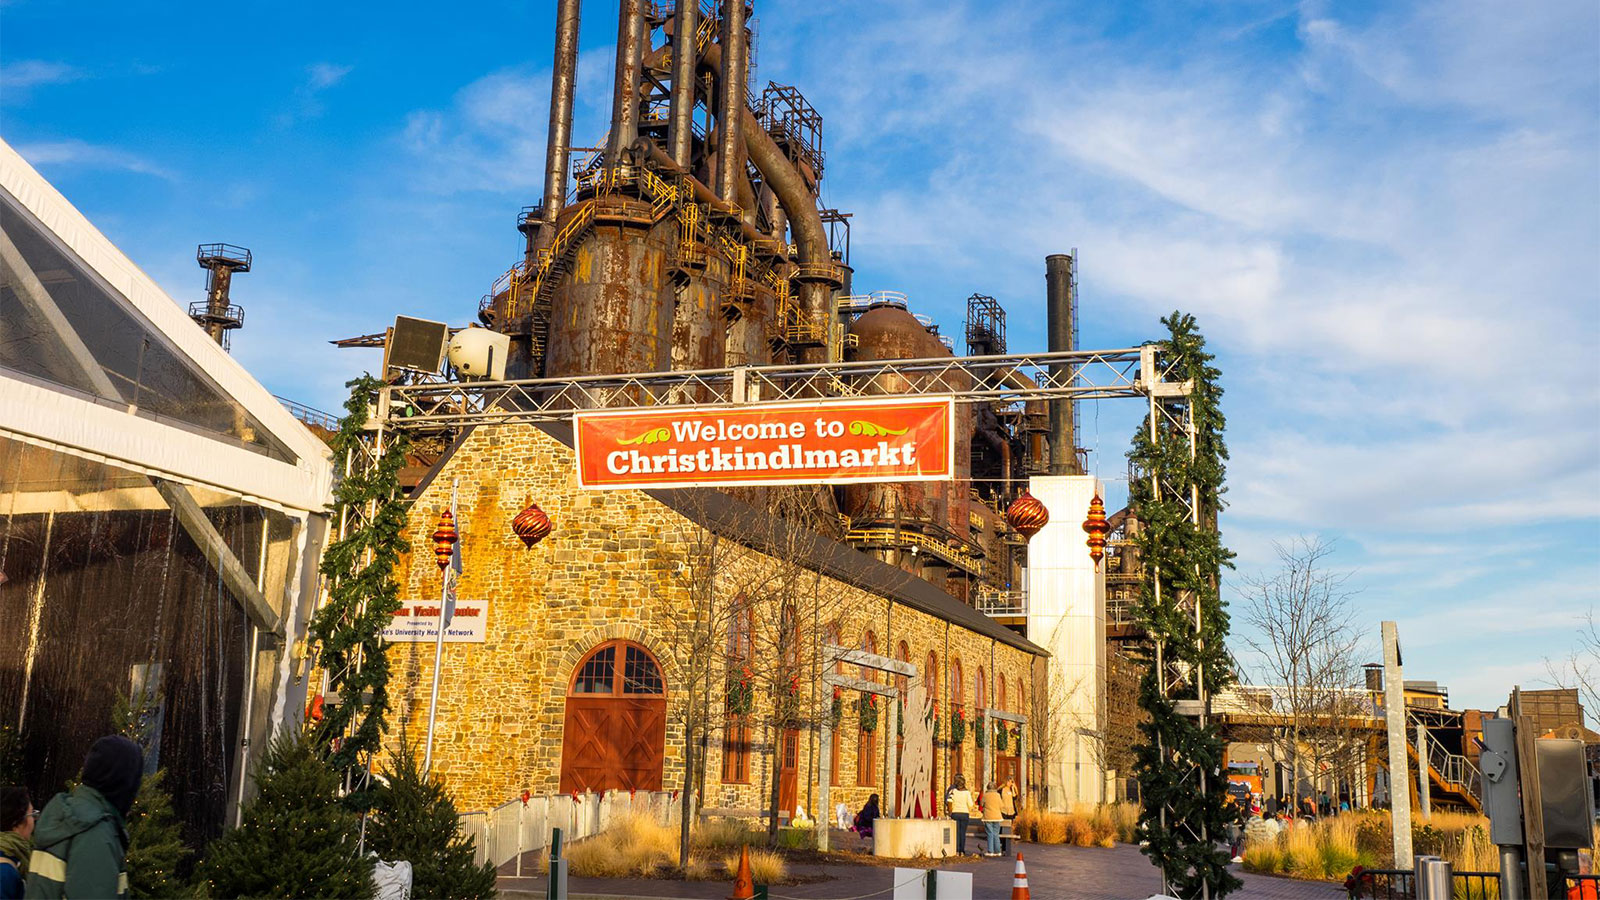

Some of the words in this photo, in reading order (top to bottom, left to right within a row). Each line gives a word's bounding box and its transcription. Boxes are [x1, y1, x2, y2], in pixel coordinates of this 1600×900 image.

[672, 417, 806, 443] Welcome
[815, 418, 845, 438] to
[606, 442, 916, 475] Christkindlmarkt
[414, 606, 441, 616] Visito
[454, 606, 480, 616] enter
